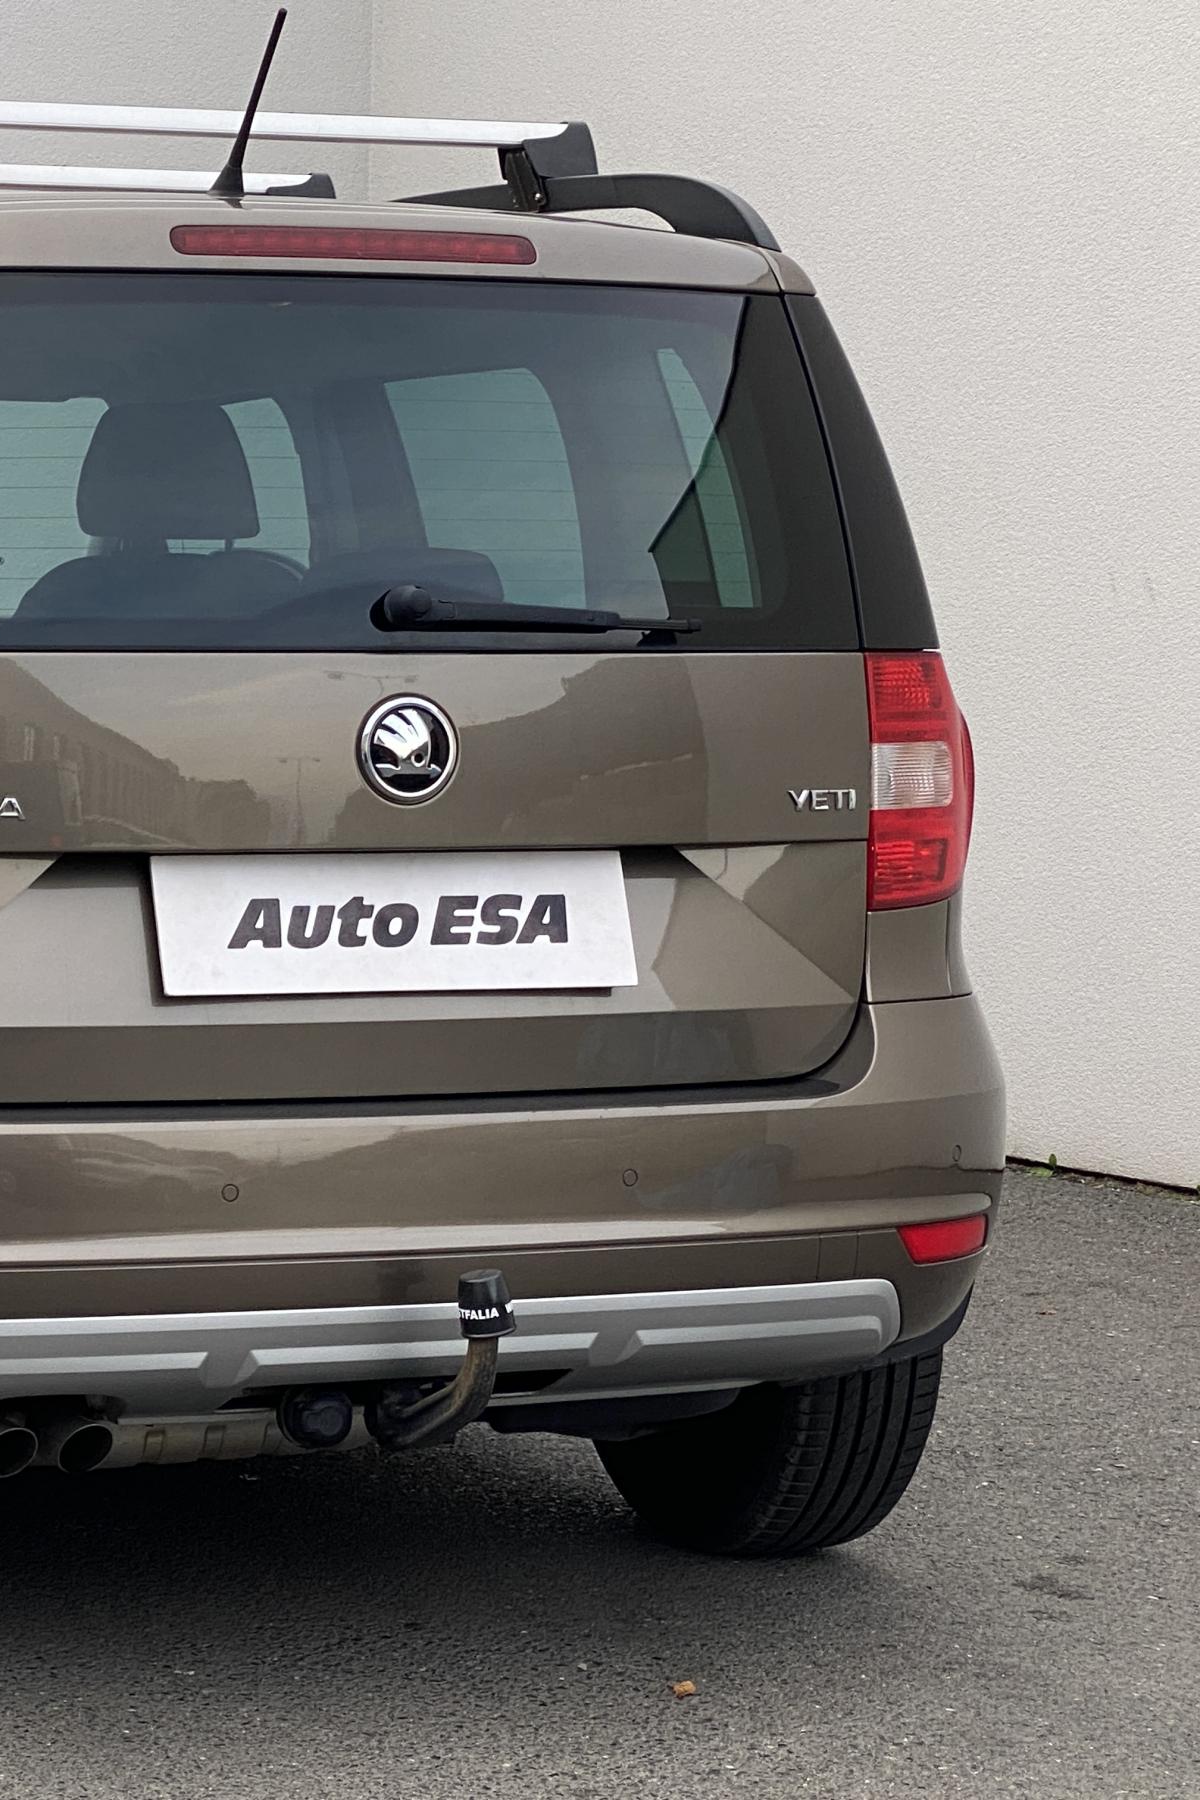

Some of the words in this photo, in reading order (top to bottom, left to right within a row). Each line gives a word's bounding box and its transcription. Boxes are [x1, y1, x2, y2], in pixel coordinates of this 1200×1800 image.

[787, 788, 857, 811] YETI
[227, 896, 419, 949] Auto
[430, 893, 569, 946] ESA
